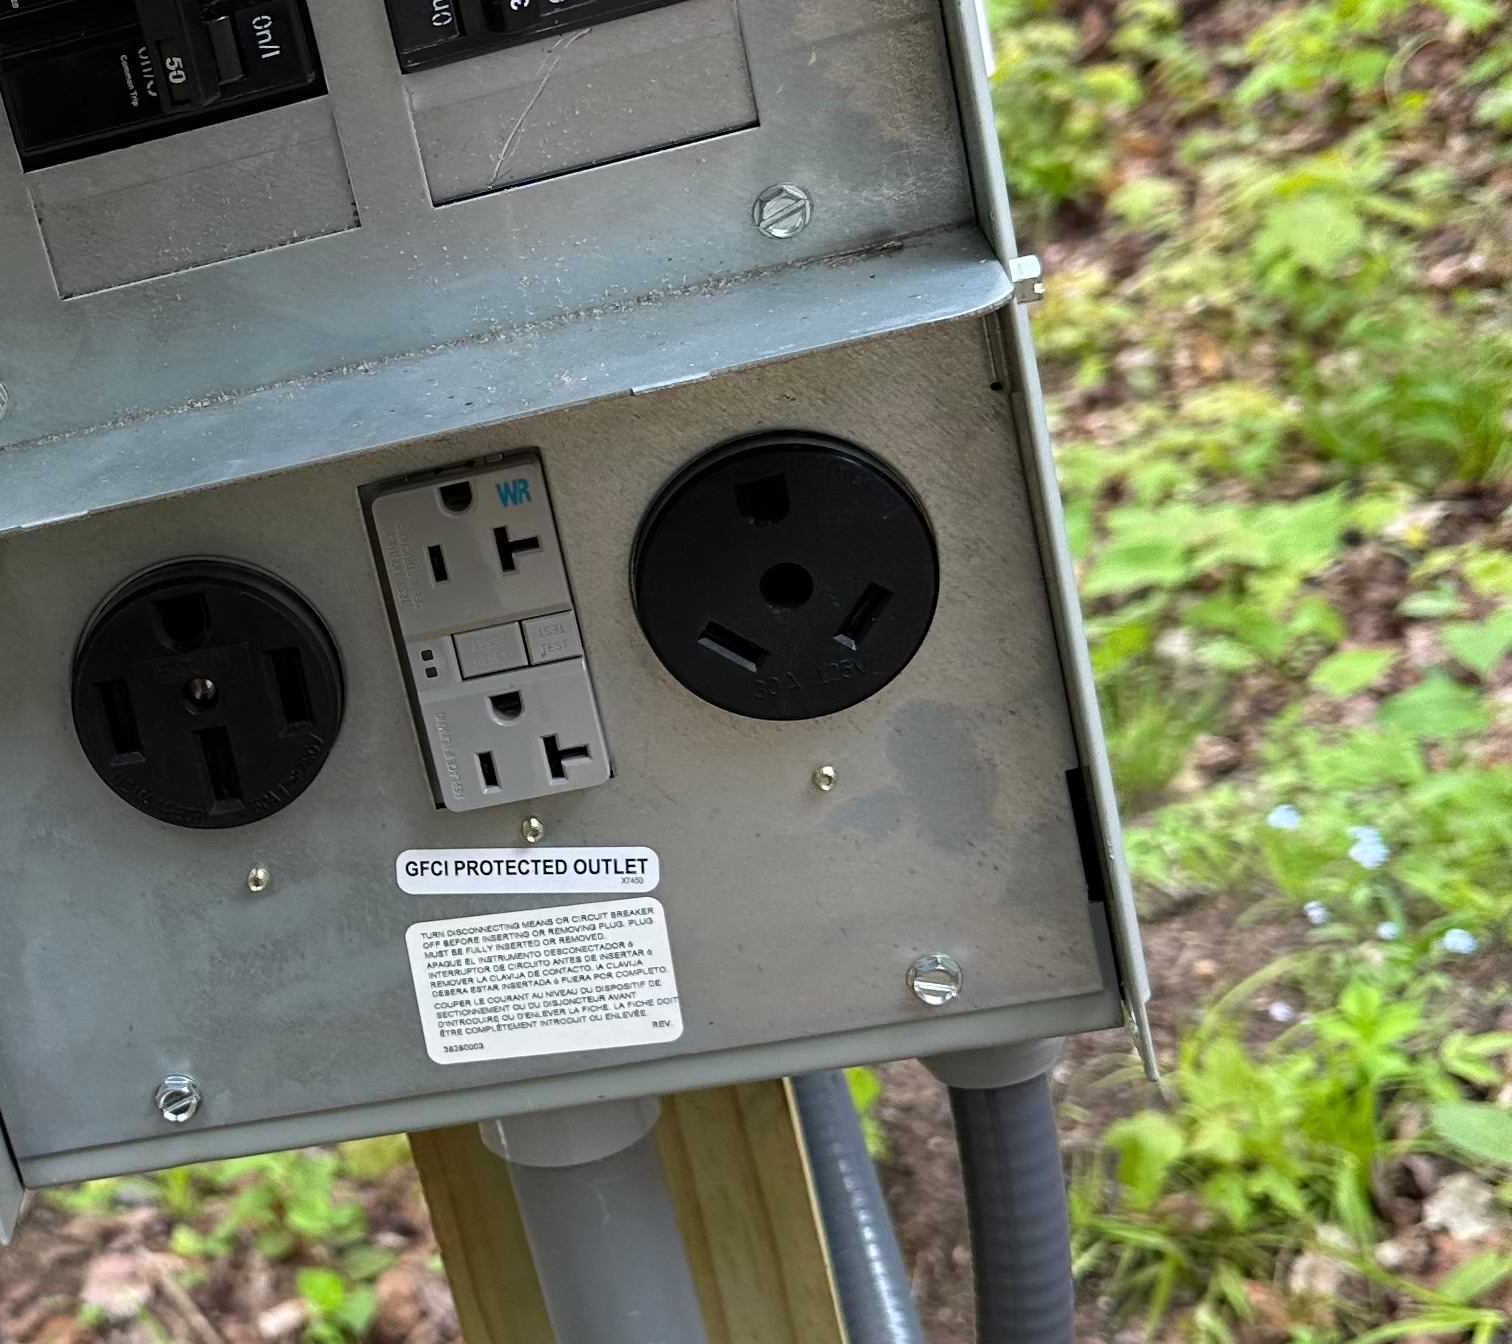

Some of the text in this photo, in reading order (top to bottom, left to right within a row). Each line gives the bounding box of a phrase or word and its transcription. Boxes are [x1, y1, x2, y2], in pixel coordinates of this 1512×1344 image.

[251, 15, 281, 59] On/I
[163, 56, 188, 85] 50
[496, 478, 532, 508] WR
[404, 857, 648, 877] GFCI PROTECTED OUTLET
[419, 906, 654, 940] TURN DISCONNECTING MEANS OR CIRCUIT BREAKER
